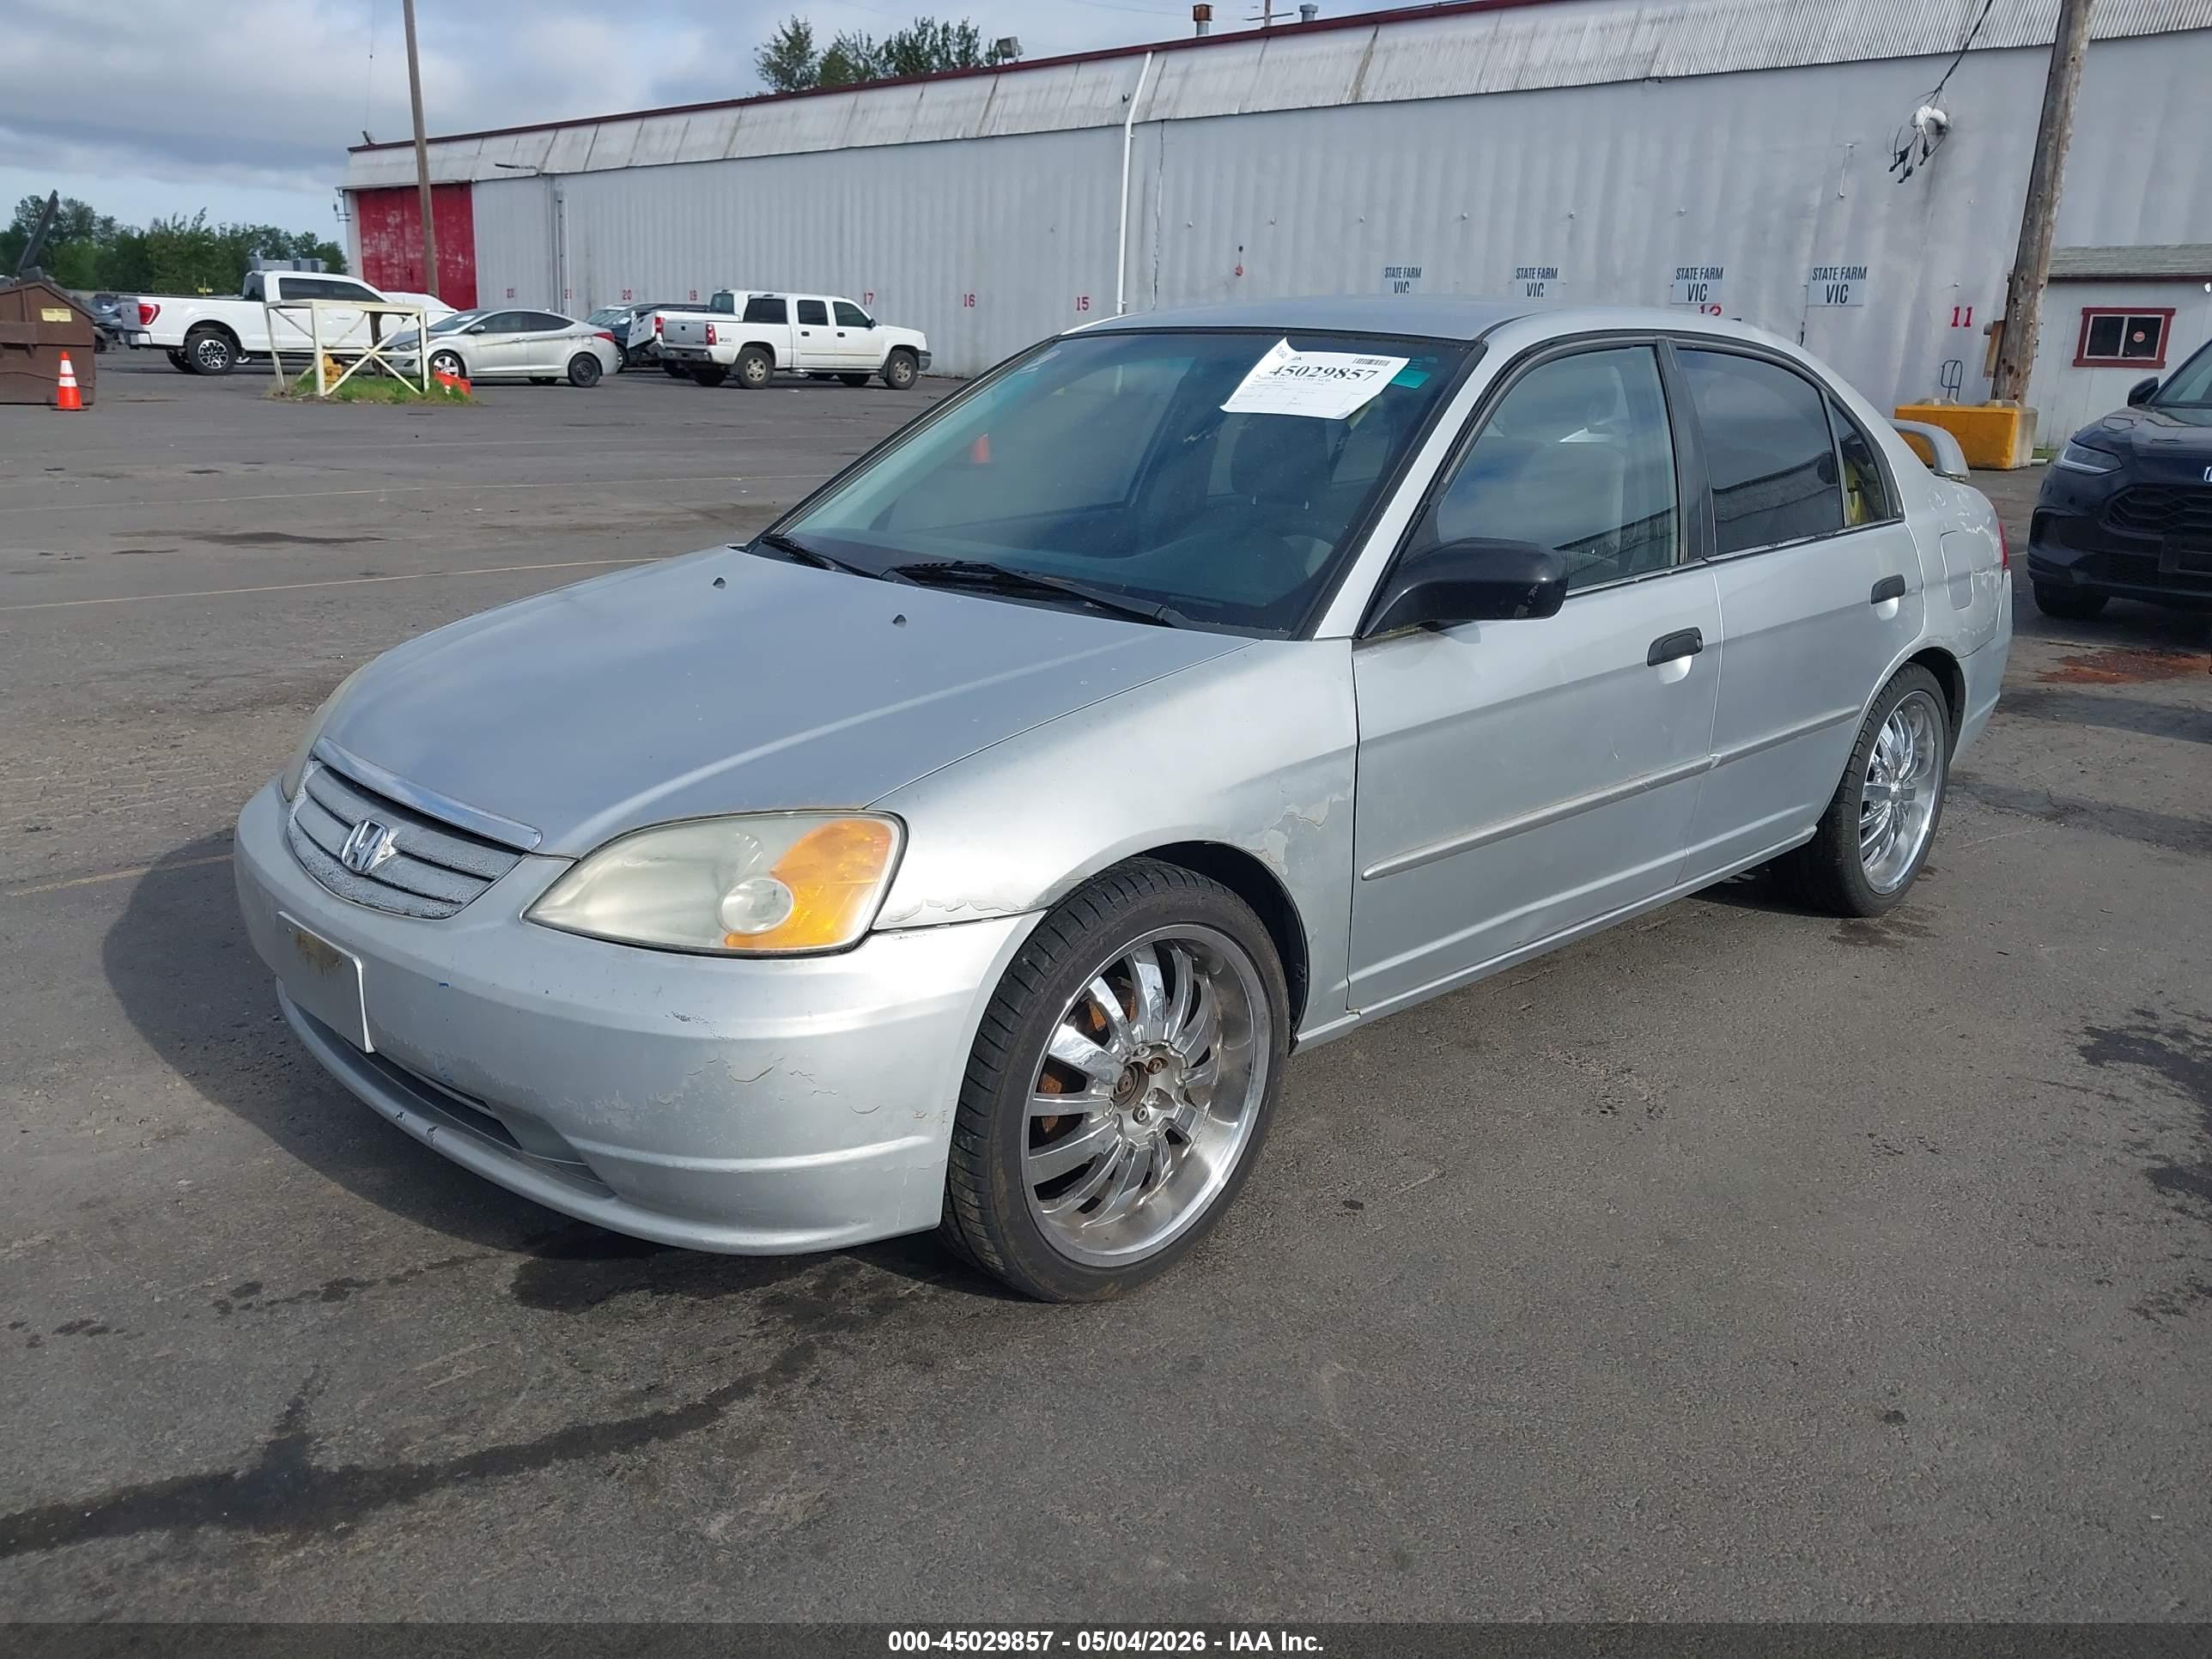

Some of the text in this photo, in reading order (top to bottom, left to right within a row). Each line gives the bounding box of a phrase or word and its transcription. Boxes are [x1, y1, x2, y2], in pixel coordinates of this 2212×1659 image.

[1384, 267, 1422, 279] STATE FARM
[1516, 267, 1559, 280] STATE FARM
[1675, 267, 1723, 281] STATE FARM
[1812, 266, 1868, 281] STATE FARM
[1394, 281, 1410, 295] VIC
[1527, 283, 1545, 297] VIC
[1687, 283, 1708, 302] VIC
[1826, 283, 1849, 304] VIC
[863, 292, 874, 306] 17
[963, 293, 975, 307] 16
[1076, 296, 1090, 311] 15
[1951, 306, 1972, 327] 11
[1269, 364, 1379, 382] 45029857
